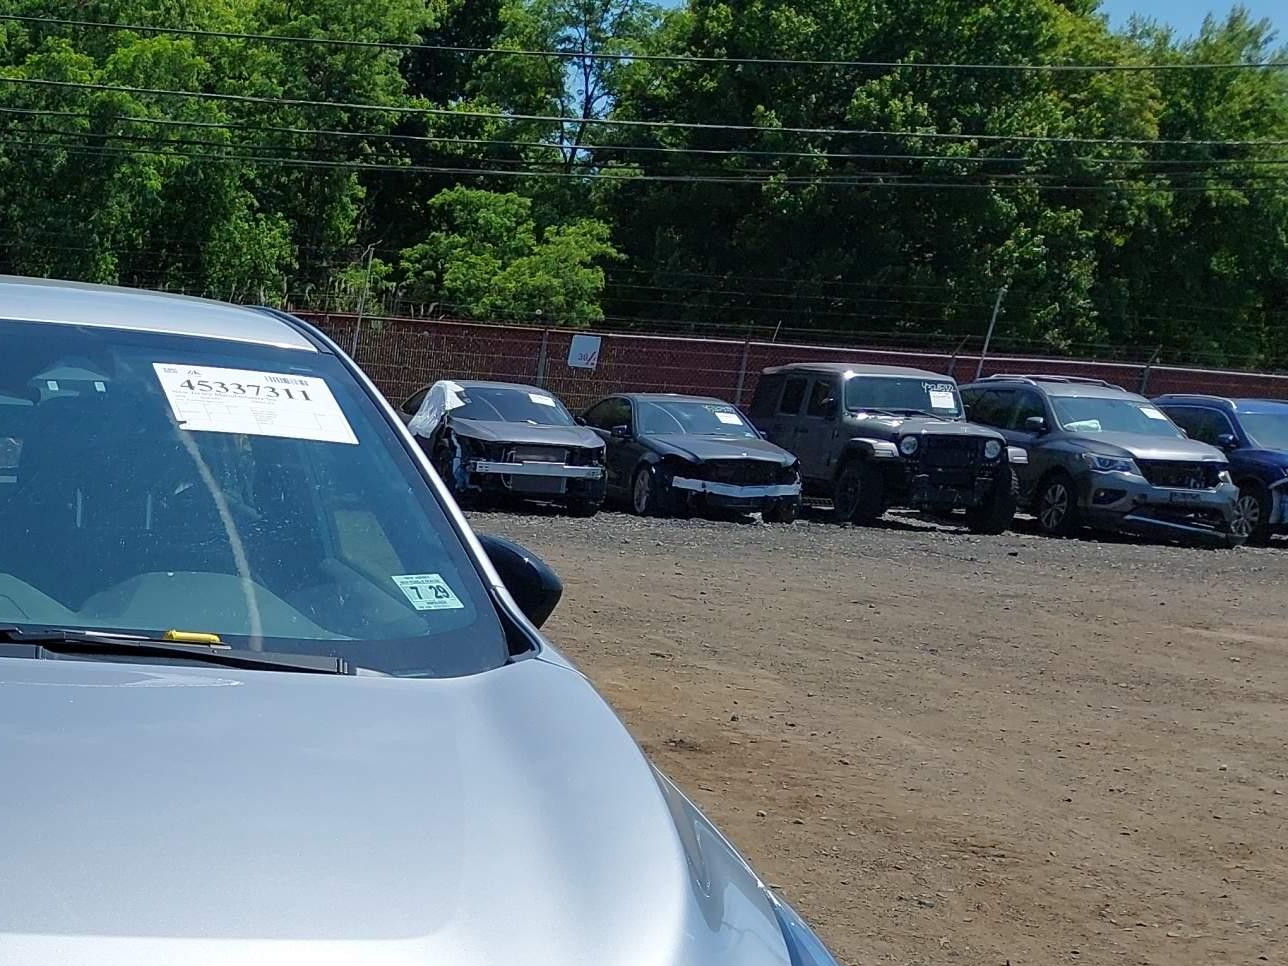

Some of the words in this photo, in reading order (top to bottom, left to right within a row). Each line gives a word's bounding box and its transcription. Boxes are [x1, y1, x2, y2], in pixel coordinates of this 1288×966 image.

[179, 378, 311, 401] 45337311
[409, 586, 423, 600] 7
[428, 585, 450, 599] 29
